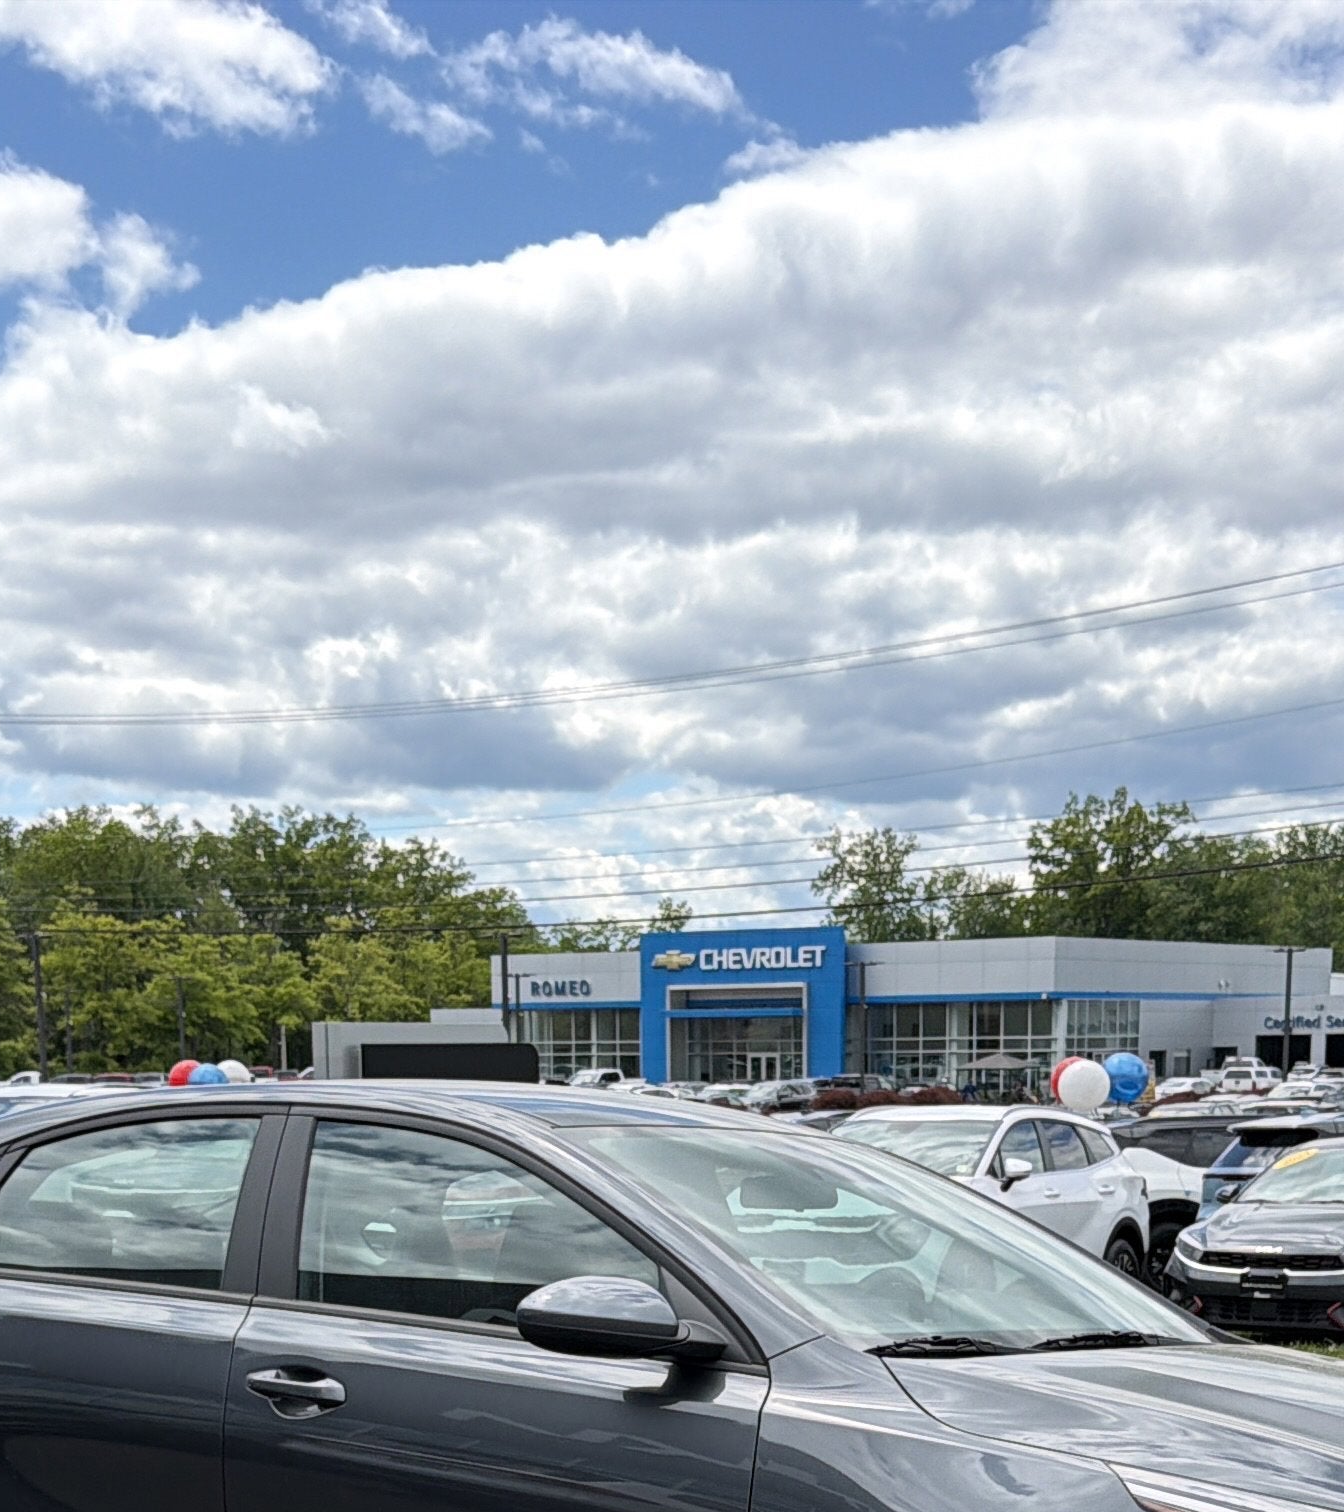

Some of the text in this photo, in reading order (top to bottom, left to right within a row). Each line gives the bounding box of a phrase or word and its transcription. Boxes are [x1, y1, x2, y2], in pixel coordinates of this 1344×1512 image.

[699, 945, 827, 971] CHEVROLET
[530, 980, 592, 997] ROMEO
[1263, 1015, 1322, 1030] Cerified
